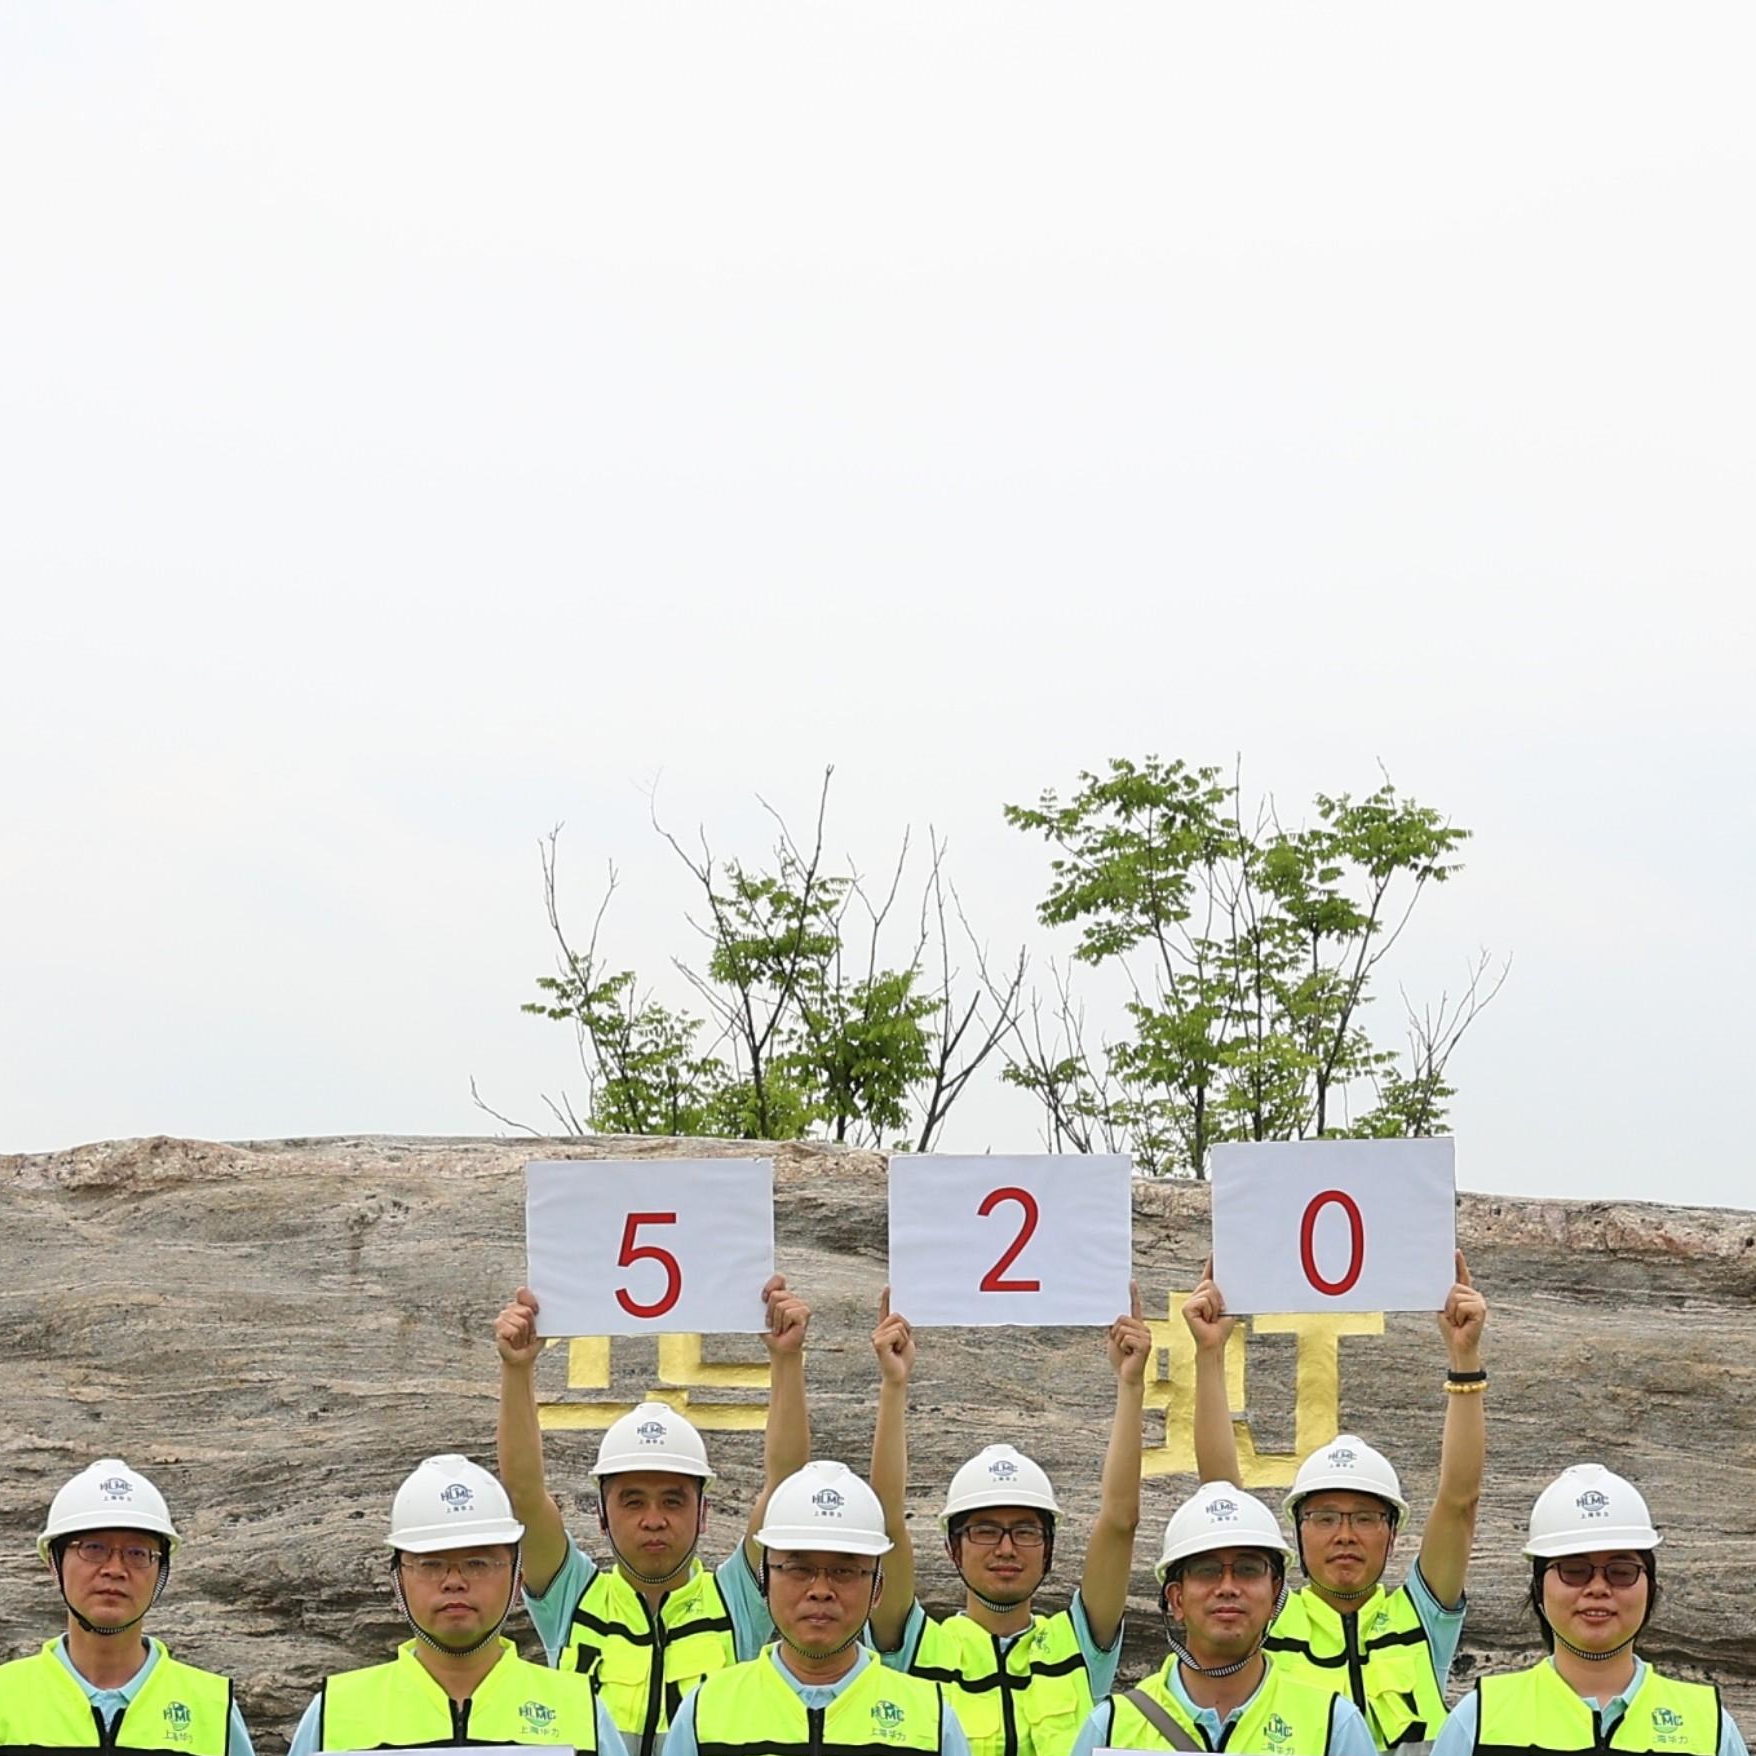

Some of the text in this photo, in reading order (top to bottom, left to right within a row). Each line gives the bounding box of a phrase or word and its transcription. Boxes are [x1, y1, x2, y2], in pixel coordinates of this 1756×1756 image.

[981, 1189, 1038, 1291] 2
[1302, 1191, 1363, 1294] 0
[618, 1213, 680, 1317] 5
[637, 1426, 667, 1435] HLMC
[100, 1481, 132, 1491] HLMC
[441, 1488, 473, 1501] HLMC
[812, 1495, 844, 1506] HLMC
[1576, 1495, 1609, 1507] HLMC
[1206, 1503, 1238, 1514] HLMC
[519, 1707, 556, 1719] HLMC
